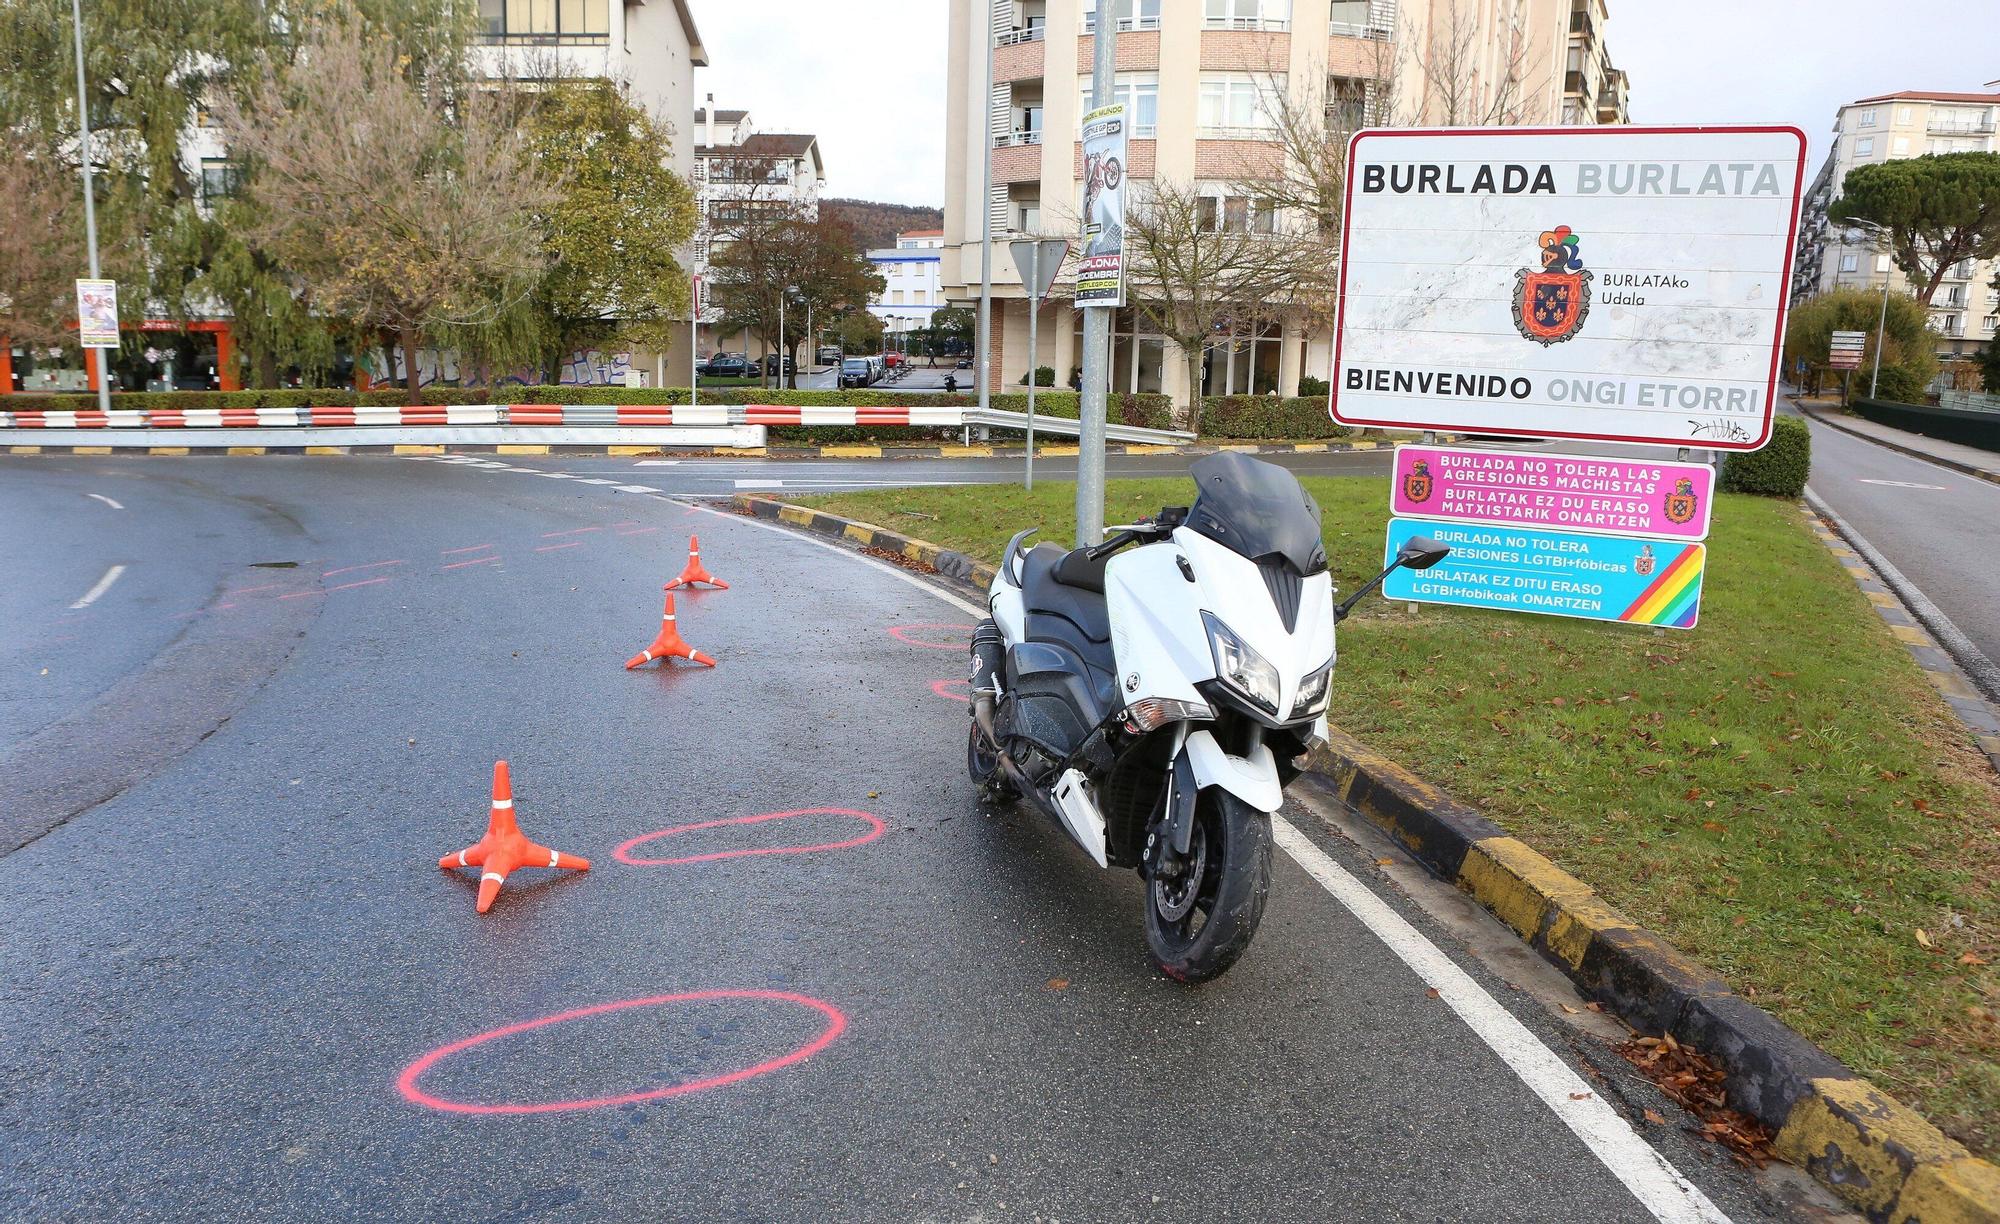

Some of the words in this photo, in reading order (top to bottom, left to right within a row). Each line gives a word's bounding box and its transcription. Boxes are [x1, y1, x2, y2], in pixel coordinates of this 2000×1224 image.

[1363, 164, 1557, 194] BURLADA
[1577, 164, 1781, 195] BURLATA
[1603, 274, 1689, 289] BURLATAko
[1602, 292, 1645, 306] Udala
[1346, 368, 1532, 399] BIENVENIDO
[1546, 378, 1626, 405] ONGI
[1637, 383, 1757, 413] ETORRI
[1440, 456, 1516, 472] BURLADA
[1523, 461, 1547, 473] NO
[1555, 463, 1620, 478] TOLERA
[1628, 468, 1661, 481] LAS
[1443, 468, 1549, 486] AGRESIONES
[1556, 476, 1656, 495] MACHISTAS
[1441, 501, 1550, 520] MATXISTARIK
[1558, 511, 1651, 528] ONARTZEN
[1445, 489, 1528, 505] BURLATAK
[1536, 495, 1554, 507] EZ
[1562, 498, 1584, 510] DU
[1591, 500, 1649, 514] ERASO
[1434, 531, 1501, 546] BURLADA
[1506, 537, 1527, 548] NO
[1532, 539, 1589, 554] TOLERA
[1448, 547, 1519, 562] RESIONES
[1523, 554, 1627, 573] LGTBI+fóbicas
[1415, 568, 1488, 585] BURLATAK
[1493, 575, 1511, 586] EZ
[1514, 577, 1547, 590] DITU
[1551, 581, 1602, 595] ERASO
[1413, 583, 1518, 602] LGTBI+fobikoak
[1522, 593, 1601, 611] ONARTZEN
